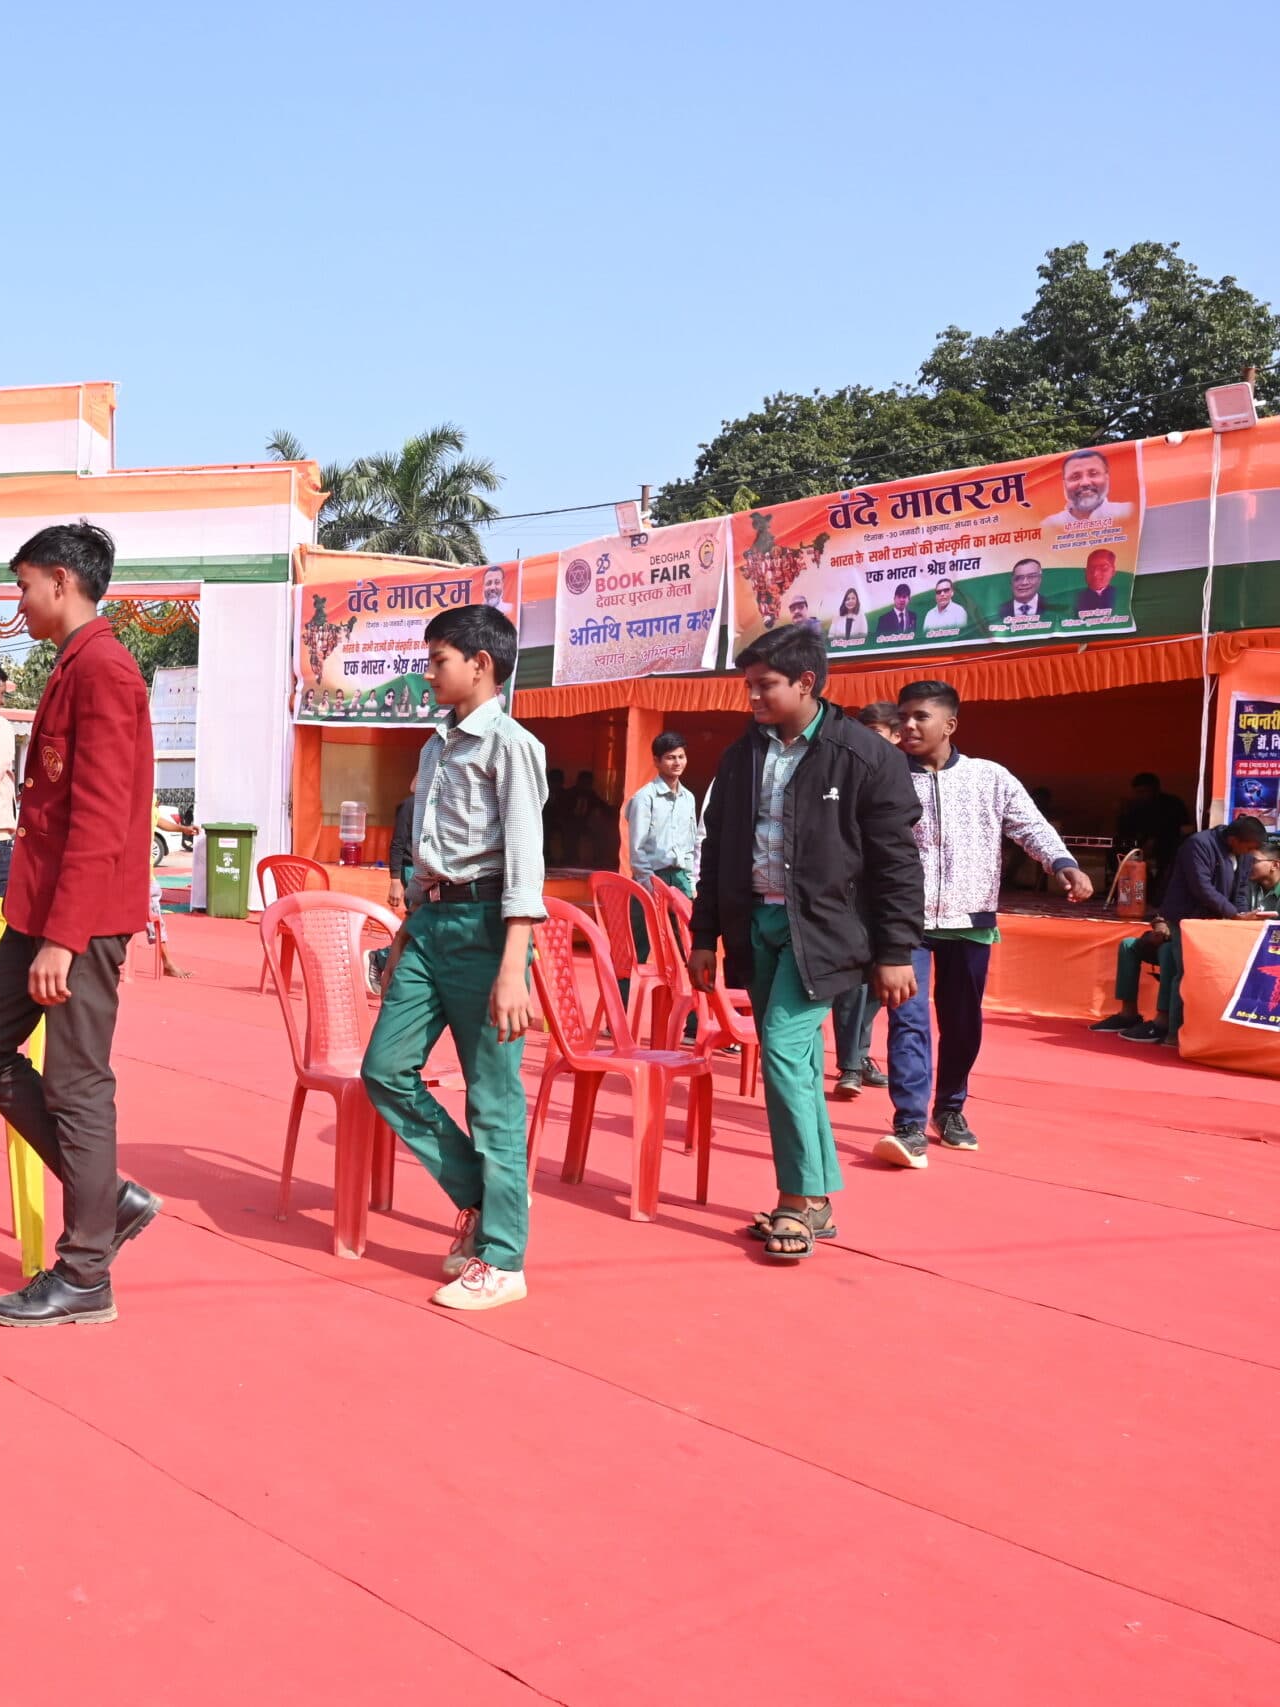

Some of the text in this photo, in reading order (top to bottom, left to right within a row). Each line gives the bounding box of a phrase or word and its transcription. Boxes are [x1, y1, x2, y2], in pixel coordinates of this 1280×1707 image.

[828, 473, 1031, 529] वंदे मातरम्
[650, 550, 690, 565] DEOGHAR
[831, 553, 854, 567] भारत
[868, 546, 890, 562] सभी
[892, 542, 917, 559] राज्यों
[919, 540, 933, 555] की
[935, 535, 971, 555] संस्कृति
[973, 535, 986, 547] का
[989, 532, 1011, 545] भव्य
[1013, 528, 1041, 542] संगम
[596, 563, 691, 592] BOOK FAIR
[865, 569, 884, 583] एक
[887, 565, 917, 579] भारत
[949, 557, 981, 571] भारत
[348, 579, 380, 612] वंदे
[596, 583, 691, 608] देवघर पुस्तक मेला
[570, 616, 621, 646] अतिथि
[626, 615, 681, 639] स्वागत
[344, 660, 359, 675] एक
[361, 659, 385, 674] भारत
[411, 658, 429, 673] भार
